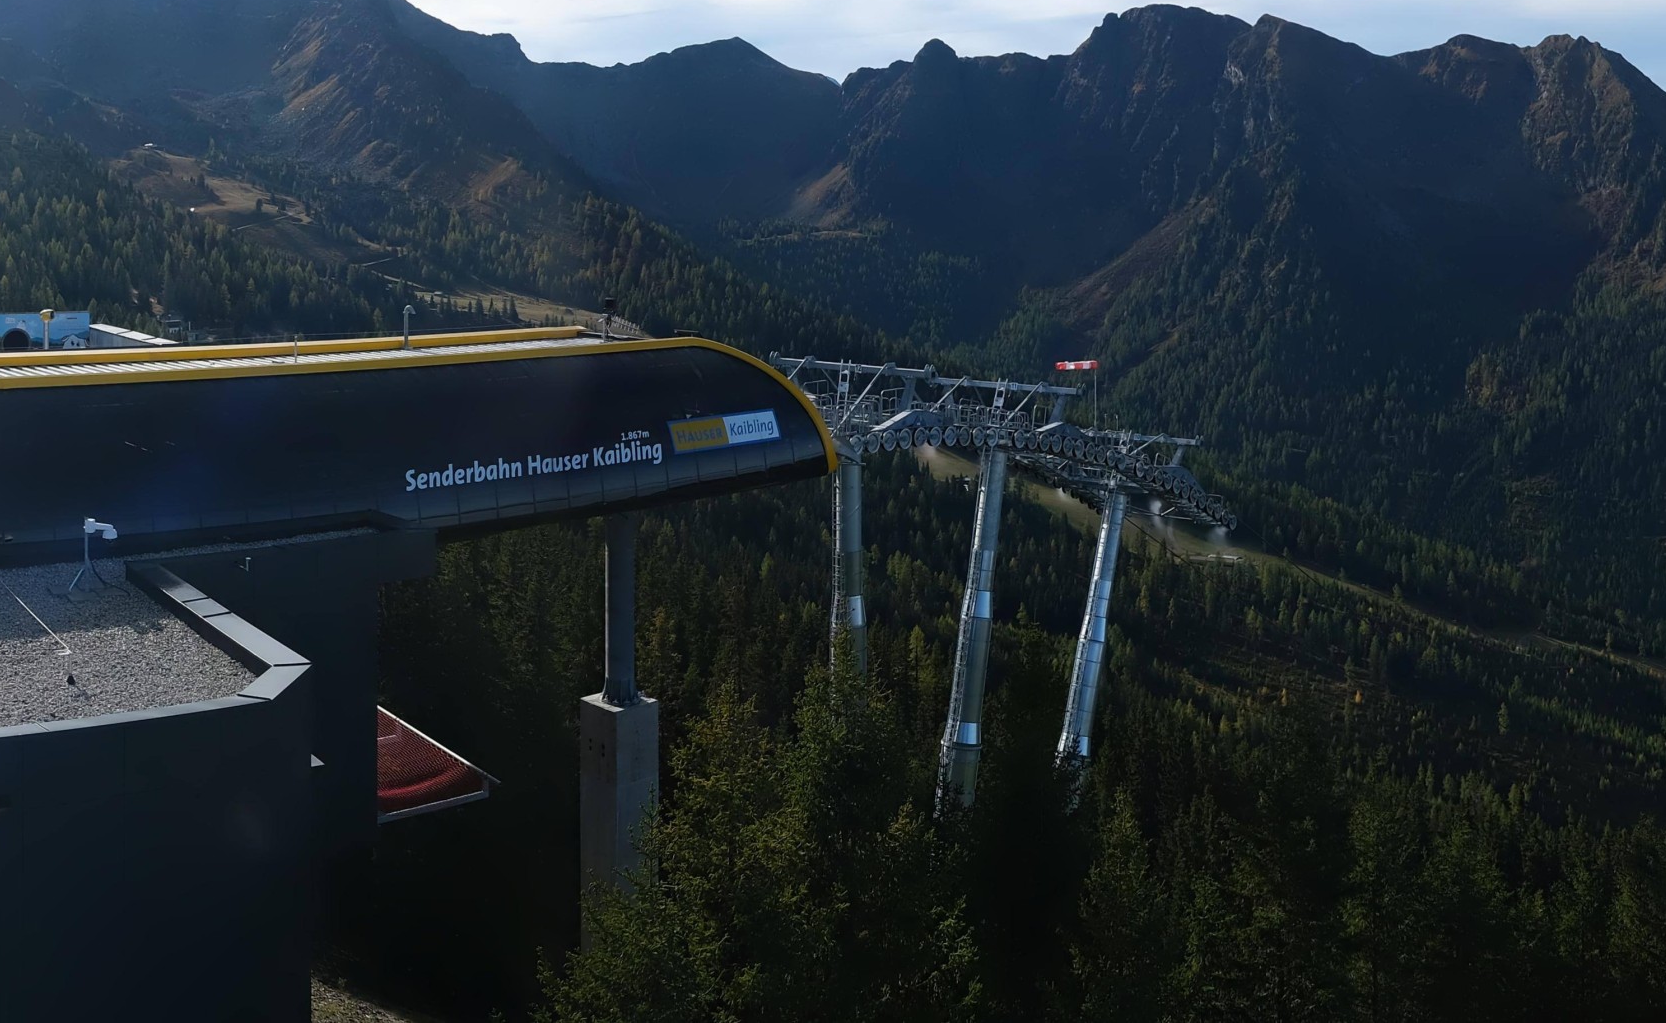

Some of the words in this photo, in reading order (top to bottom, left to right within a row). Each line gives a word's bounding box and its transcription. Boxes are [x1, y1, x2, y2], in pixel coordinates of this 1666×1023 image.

[620, 430, 650, 441] 1.867m
[676, 427, 723, 444] HAUSER
[729, 420, 774, 437] Kaibling
[405, 456, 522, 492] Senderbahn
[528, 454, 589, 476] Hauser
[593, 441, 662, 467] Kaibling
